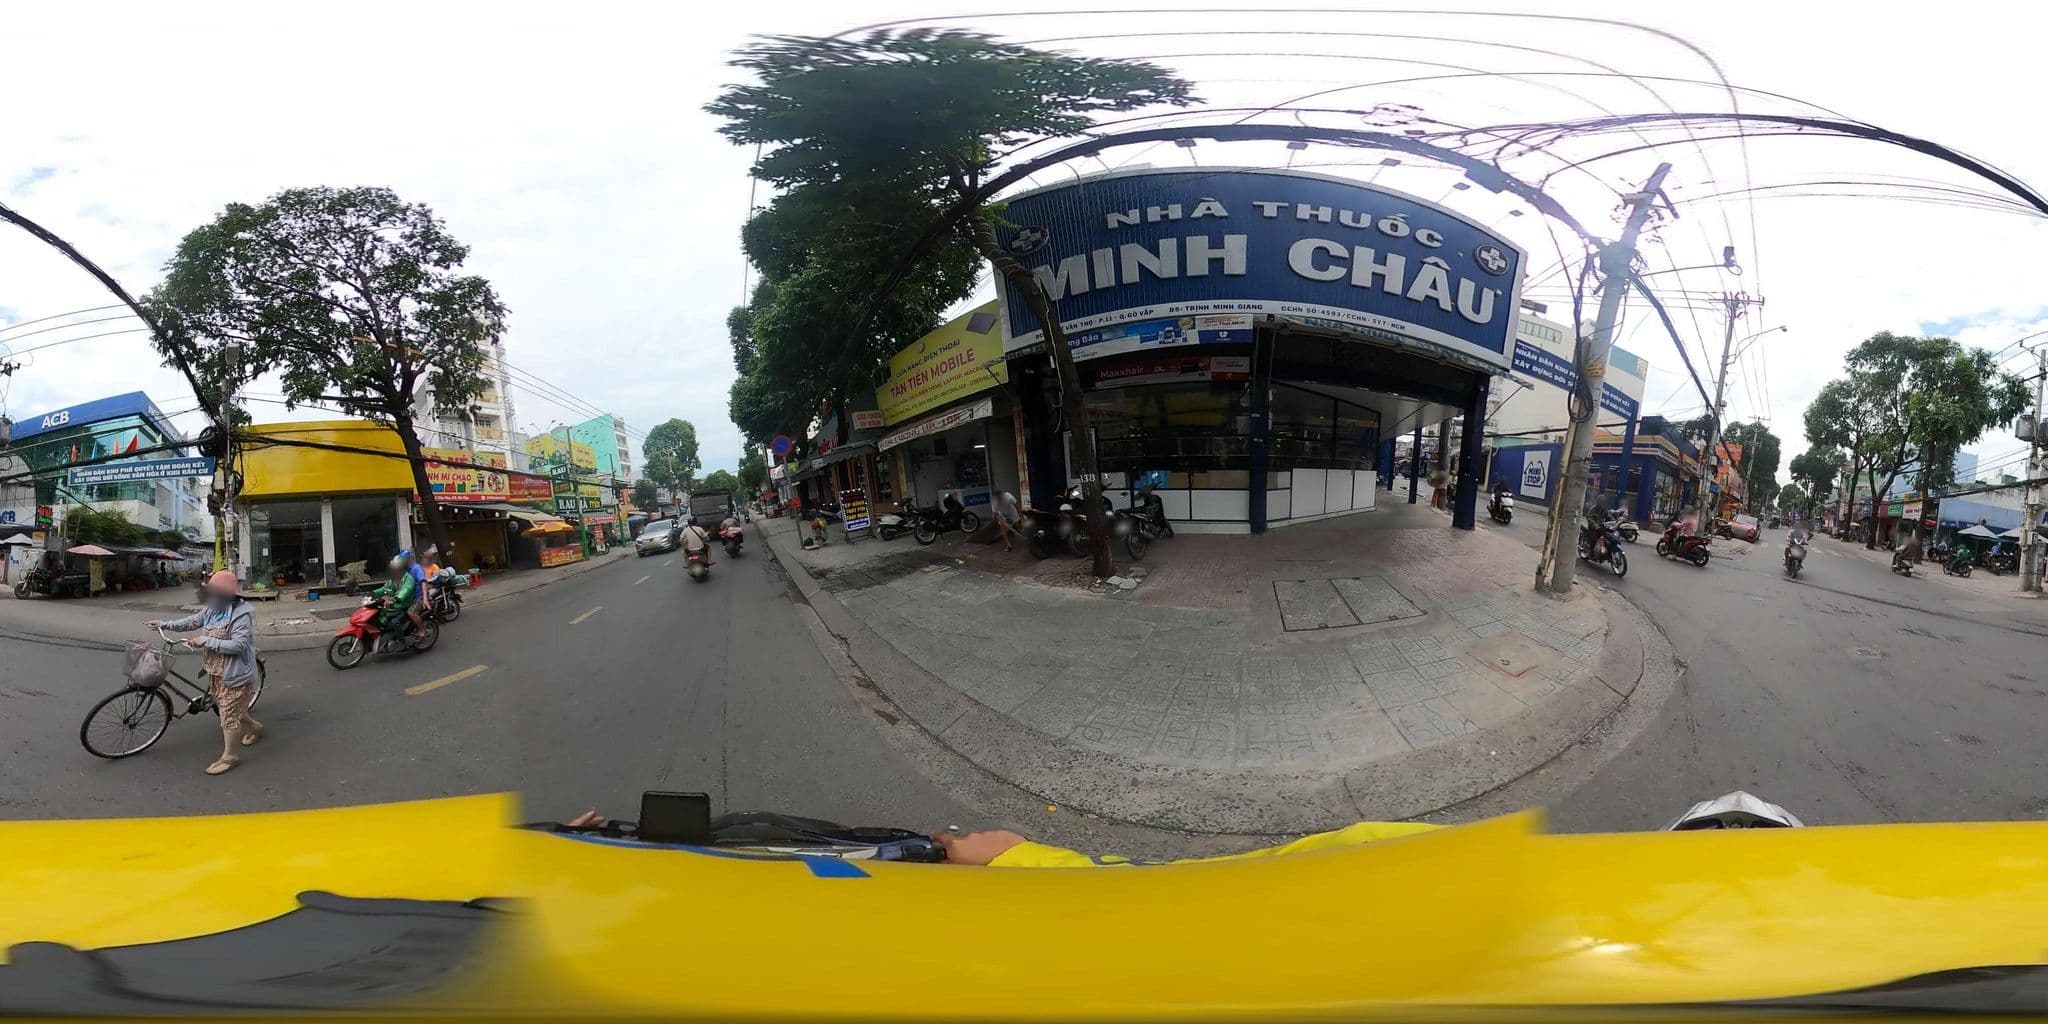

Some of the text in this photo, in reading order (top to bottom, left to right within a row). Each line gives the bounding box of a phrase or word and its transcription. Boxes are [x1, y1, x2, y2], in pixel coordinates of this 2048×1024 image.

[1107, 197, 1444, 248] NHÀ THUỐC
[1032, 234, 1496, 325] MINH CHÂU
[1185, 304, 1210, 313] TRỊNH
[1238, 303, 1263, 311] GIANG
[1281, 305, 1303, 313] CCHN
[907, 360, 923, 372] HÀNG
[923, 351, 938, 364] ĐIỆN
[938, 339, 961, 354] THOẠI
[1515, 347, 1537, 361] NHÂN
[1514, 358, 1530, 369] XÂY
[890, 380, 907, 398] TÂN
[930, 348, 976, 379] MOBILE
[1100, 366, 1144, 378] Maxxhair
[41, 411, 70, 429] ACB
[552, 466, 566, 475] RAU
[559, 499, 576, 509] RAU
